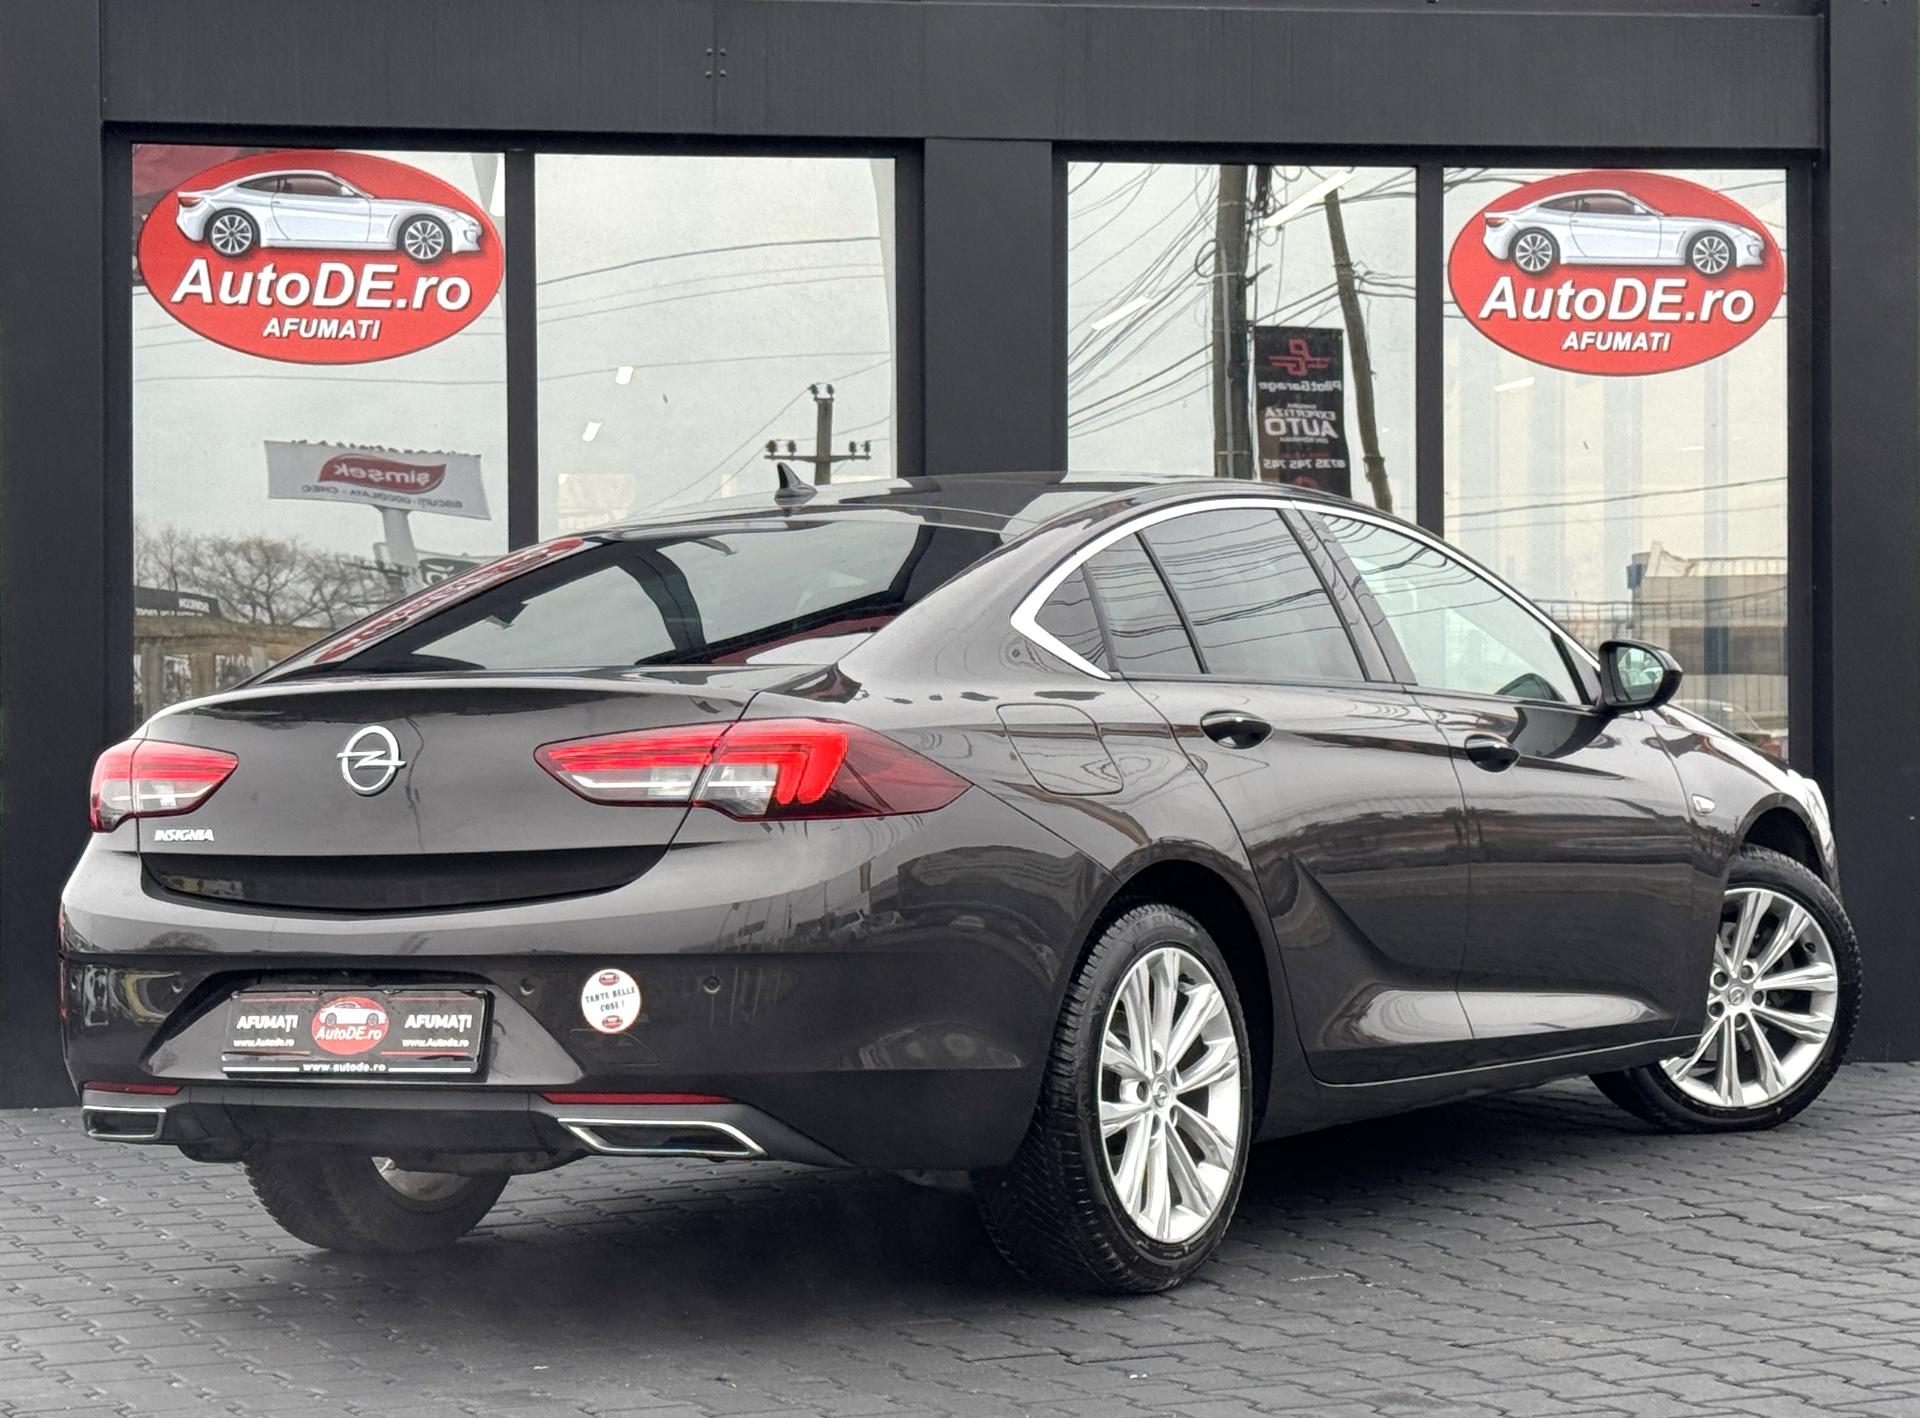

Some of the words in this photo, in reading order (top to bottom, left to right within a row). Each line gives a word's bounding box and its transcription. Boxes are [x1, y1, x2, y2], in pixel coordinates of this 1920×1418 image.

[170, 258, 472, 312] AutoDE.ro
[1478, 276, 1756, 323] AutoDE.ro
[262, 317, 381, 341] AFUMATI
[1561, 331, 1672, 353] AFUMATI
[154, 828, 215, 841] INSIGNIA
[314, 1025, 383, 1041] AutoDE.ro
[302, 1062, 387, 1073] www.autode.ro
